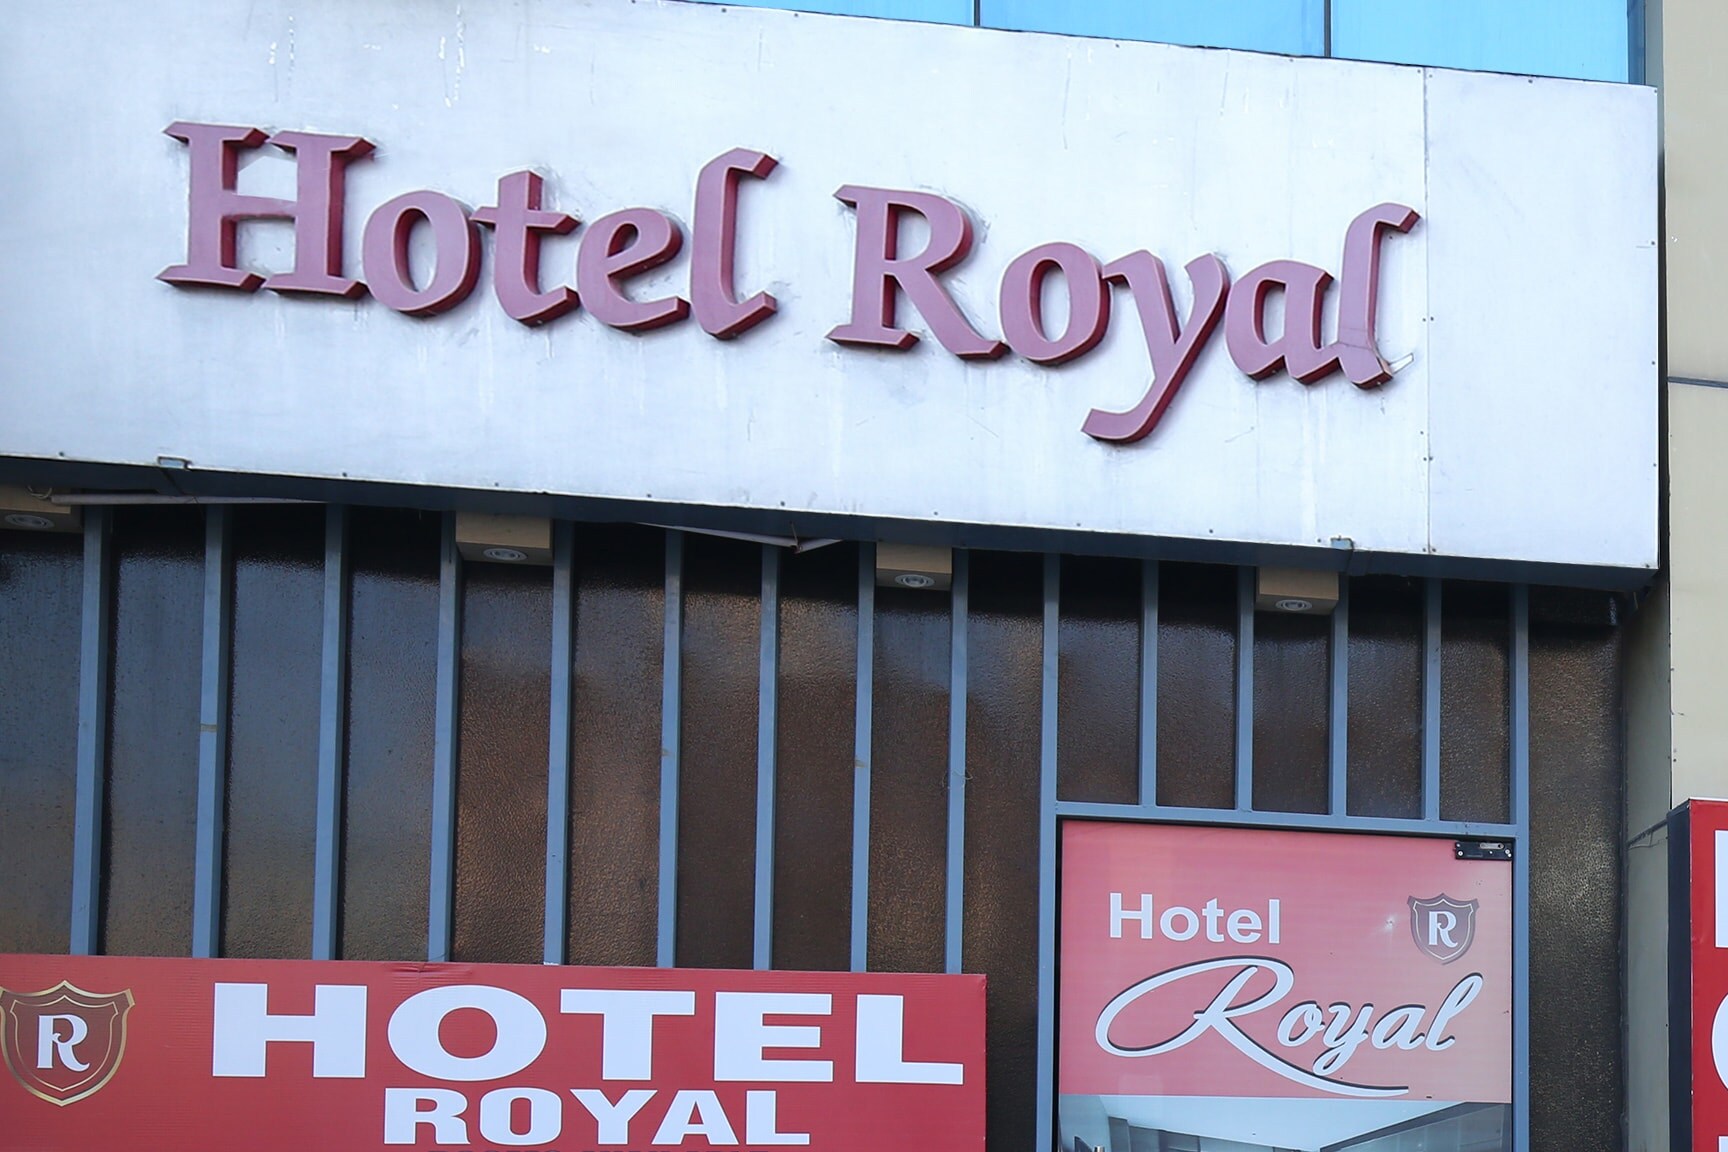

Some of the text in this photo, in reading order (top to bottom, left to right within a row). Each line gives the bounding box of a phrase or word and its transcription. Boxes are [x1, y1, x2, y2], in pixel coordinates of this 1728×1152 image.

[155, 120, 1421, 443] Hotel Royal
[1110, 893, 1279, 943] Hotel
[1429, 911, 1458, 948] R
[37, 1014, 89, 1071] R
[213, 983, 963, 1084] HOTEL
[1095, 955, 1483, 1096] Royal
[384, 1088, 809, 1145] ROYAL
